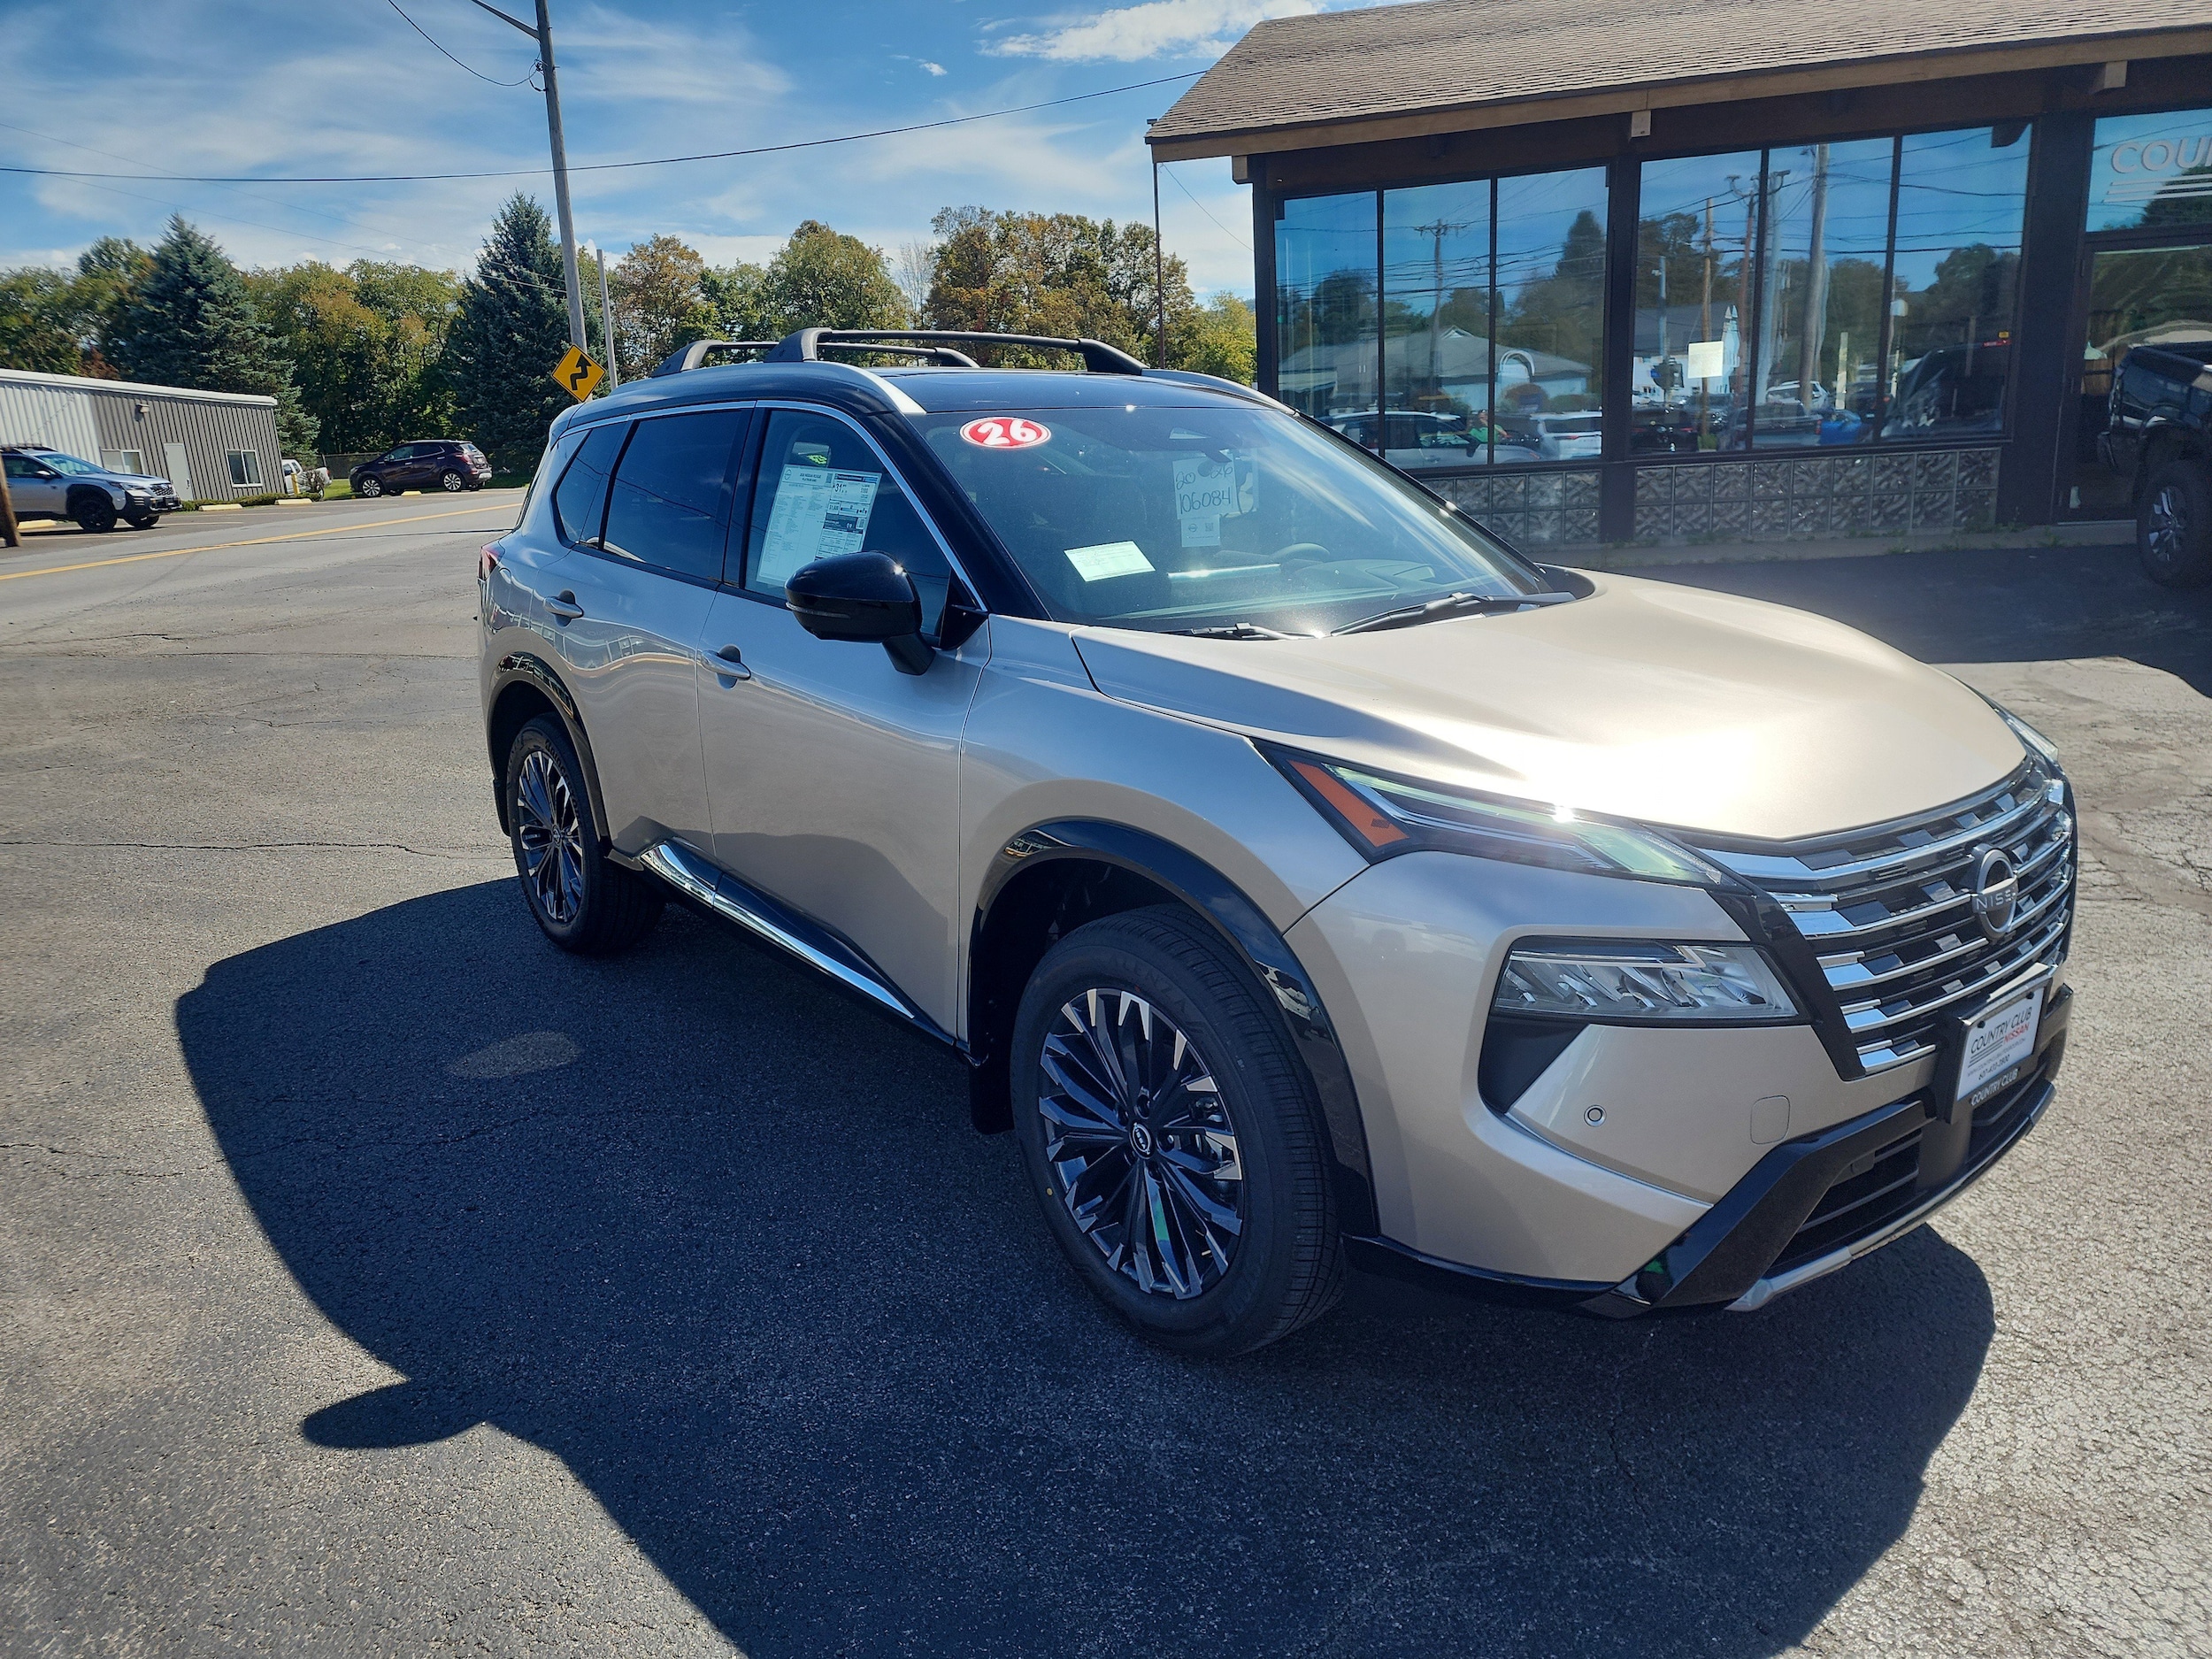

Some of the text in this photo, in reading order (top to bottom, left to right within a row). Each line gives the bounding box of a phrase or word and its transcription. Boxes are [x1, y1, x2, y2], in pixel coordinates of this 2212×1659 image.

[2111, 135, 2211, 173] COU
[977, 419, 1037, 445] 26
[1179, 487, 1232, 515] 106084
[1976, 887, 2016, 910] NISS
[1970, 1006, 2032, 1054] COUNTRY CLUB
[2003, 1023, 2030, 1043] NISSAN
[1970, 1068, 2019, 1106] COUNTRY CLUB
